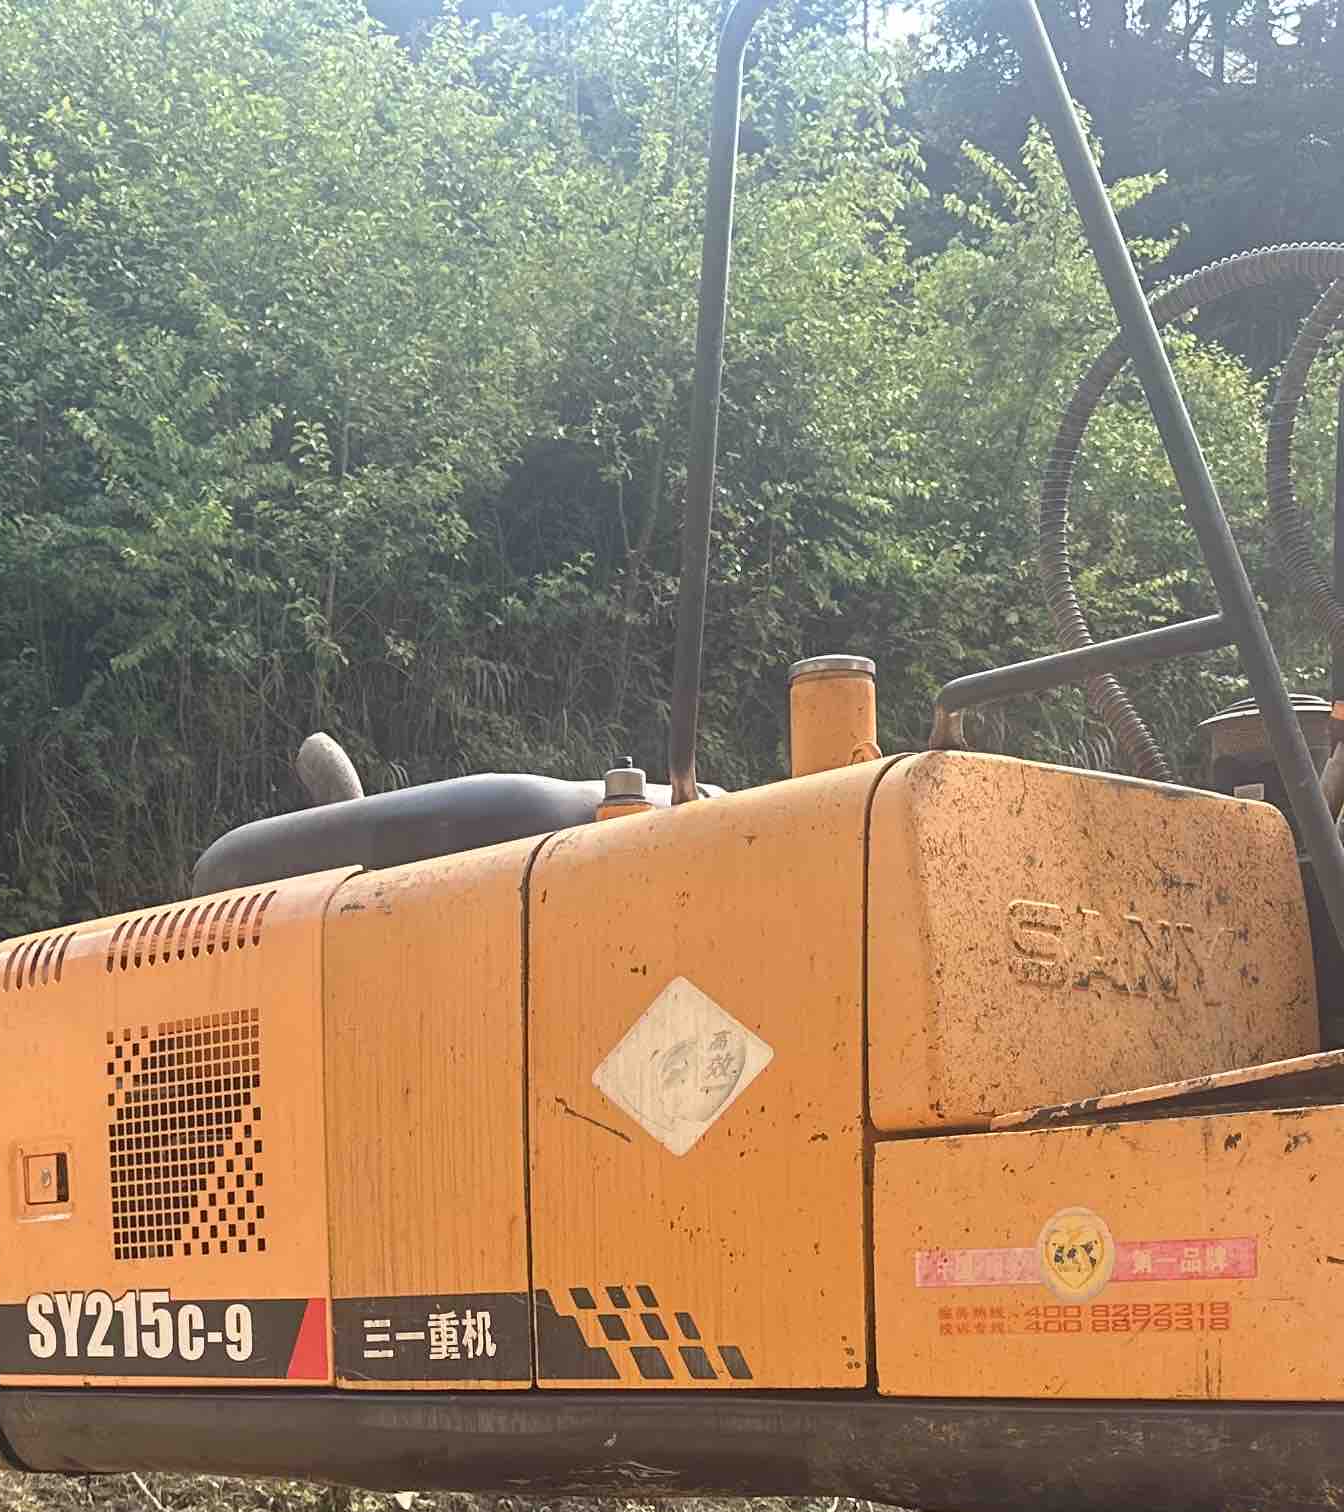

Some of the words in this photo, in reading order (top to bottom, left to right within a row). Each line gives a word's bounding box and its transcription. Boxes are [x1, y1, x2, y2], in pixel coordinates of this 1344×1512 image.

[703, 1030, 738, 1080] 高效
[1132, 1246, 1229, 1277] 第一品牌
[1022, 1304, 1083, 1318] 400
[1090, 1302, 1232, 1318] 8282318
[1022, 1319, 1083, 1333] 400
[1090, 1318, 1232, 1333] 8879318
[362, 1307, 498, 1361] 三一重机
